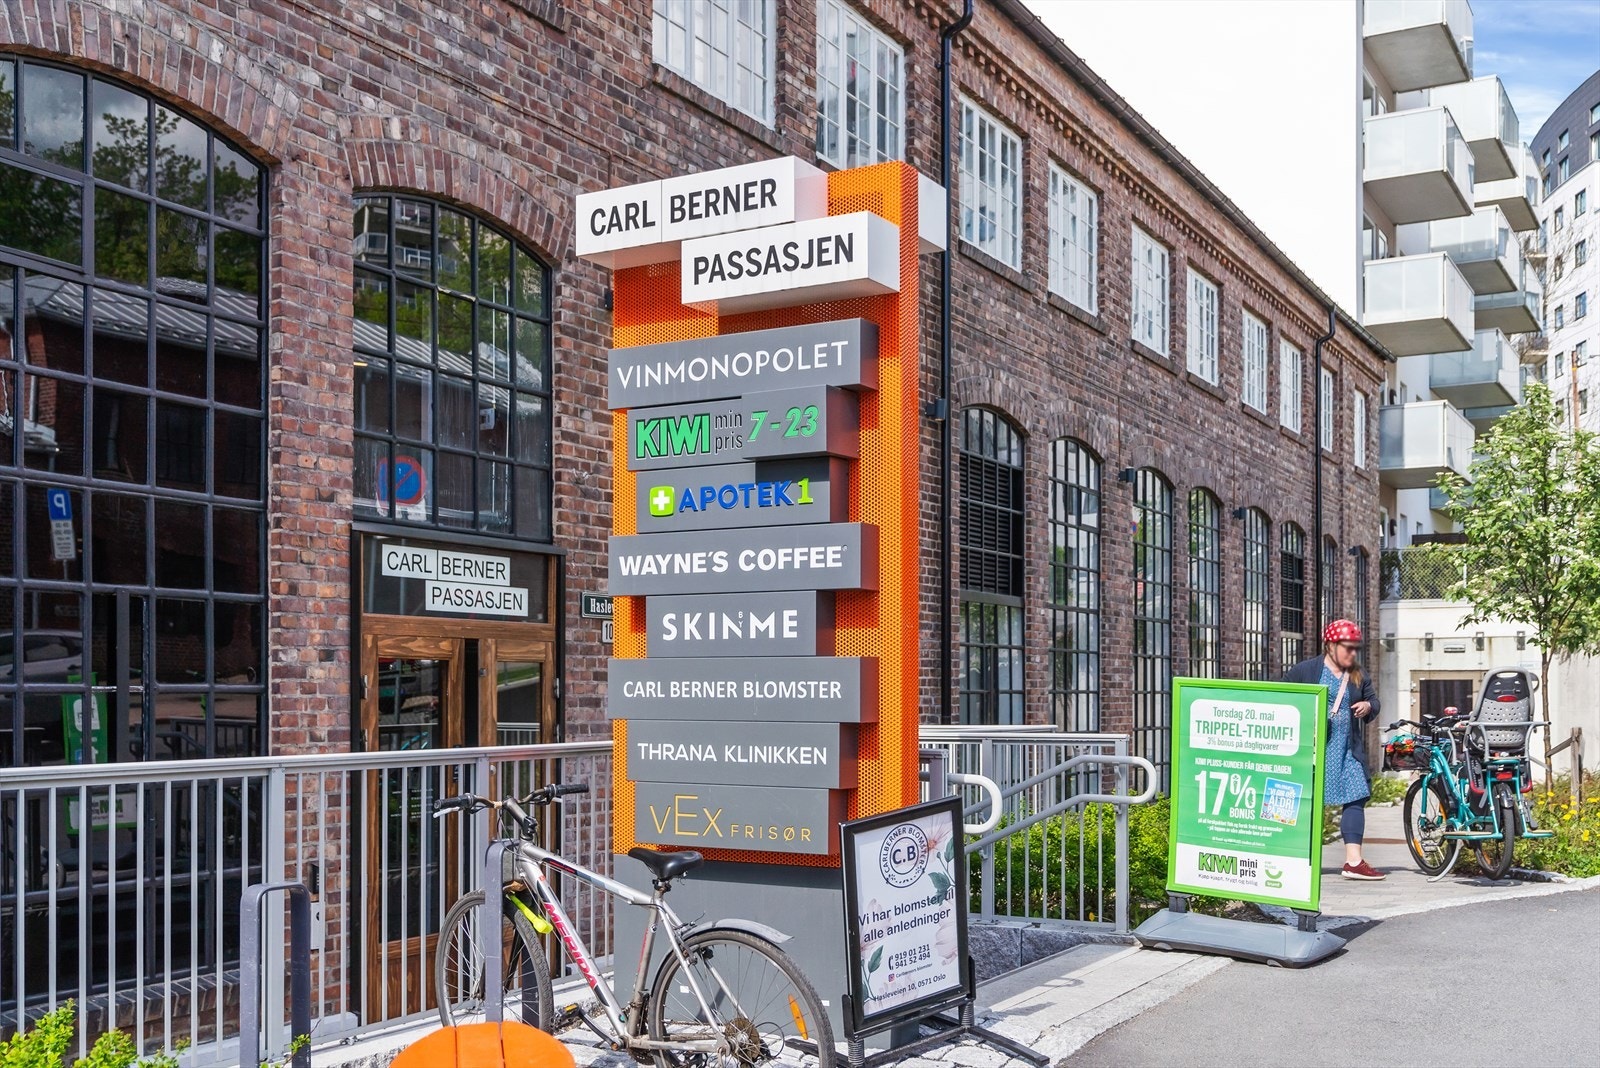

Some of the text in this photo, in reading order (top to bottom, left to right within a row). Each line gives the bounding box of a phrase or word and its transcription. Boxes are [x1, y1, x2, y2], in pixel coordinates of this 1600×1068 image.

[590, 178, 777, 237] CARL BERNER
[693, 232, 854, 286] PASSASJEN
[616, 340, 849, 390] VINMONOPOLET
[636, 413, 711, 460] KIWI
[714, 431, 743, 456] pris
[386, 551, 507, 580] CARL BERNER
[618, 545, 843, 577] WAYNE'S COFFEE
[432, 586, 523, 611] PASSASJEN
[623, 680, 842, 700] CARL BERNER BLOMSTER
[1213, 706, 1275, 721] Torsdag 20. mai
[1195, 720, 1293, 741] TRIPPEL-TRUMF!
[637, 743, 827, 765] THRANA KLINIKKEN
[1207, 737, 1279, 751] 3% bonus på dagligvarer
[1245, 761, 1254, 770] FÅR
[1194, 771, 1256, 815] 17%
[1269, 795, 1295, 810] ALDRI
[1229, 807, 1256, 820] BONUS
[731, 824, 811, 842] FRISØR
[892, 845, 916, 865] C.B
[1198, 852, 1238, 875] KIWI
[1239, 859, 1258, 869] mini
[1239, 868, 1257, 878] pris
[859, 913, 869, 926] Vi
[872, 909, 891, 922] har
[894, 896, 940, 916] blomster
[864, 908, 951, 943] alle anledninger
[544, 902, 598, 989] MERIDA
[895, 944, 930, 961] 919 01 231
[895, 952, 931, 969] 941 52 494
[908, 984, 917, 992] 10,
[918, 977, 932, 988] 0571
[933, 973, 946, 983] Oslo
